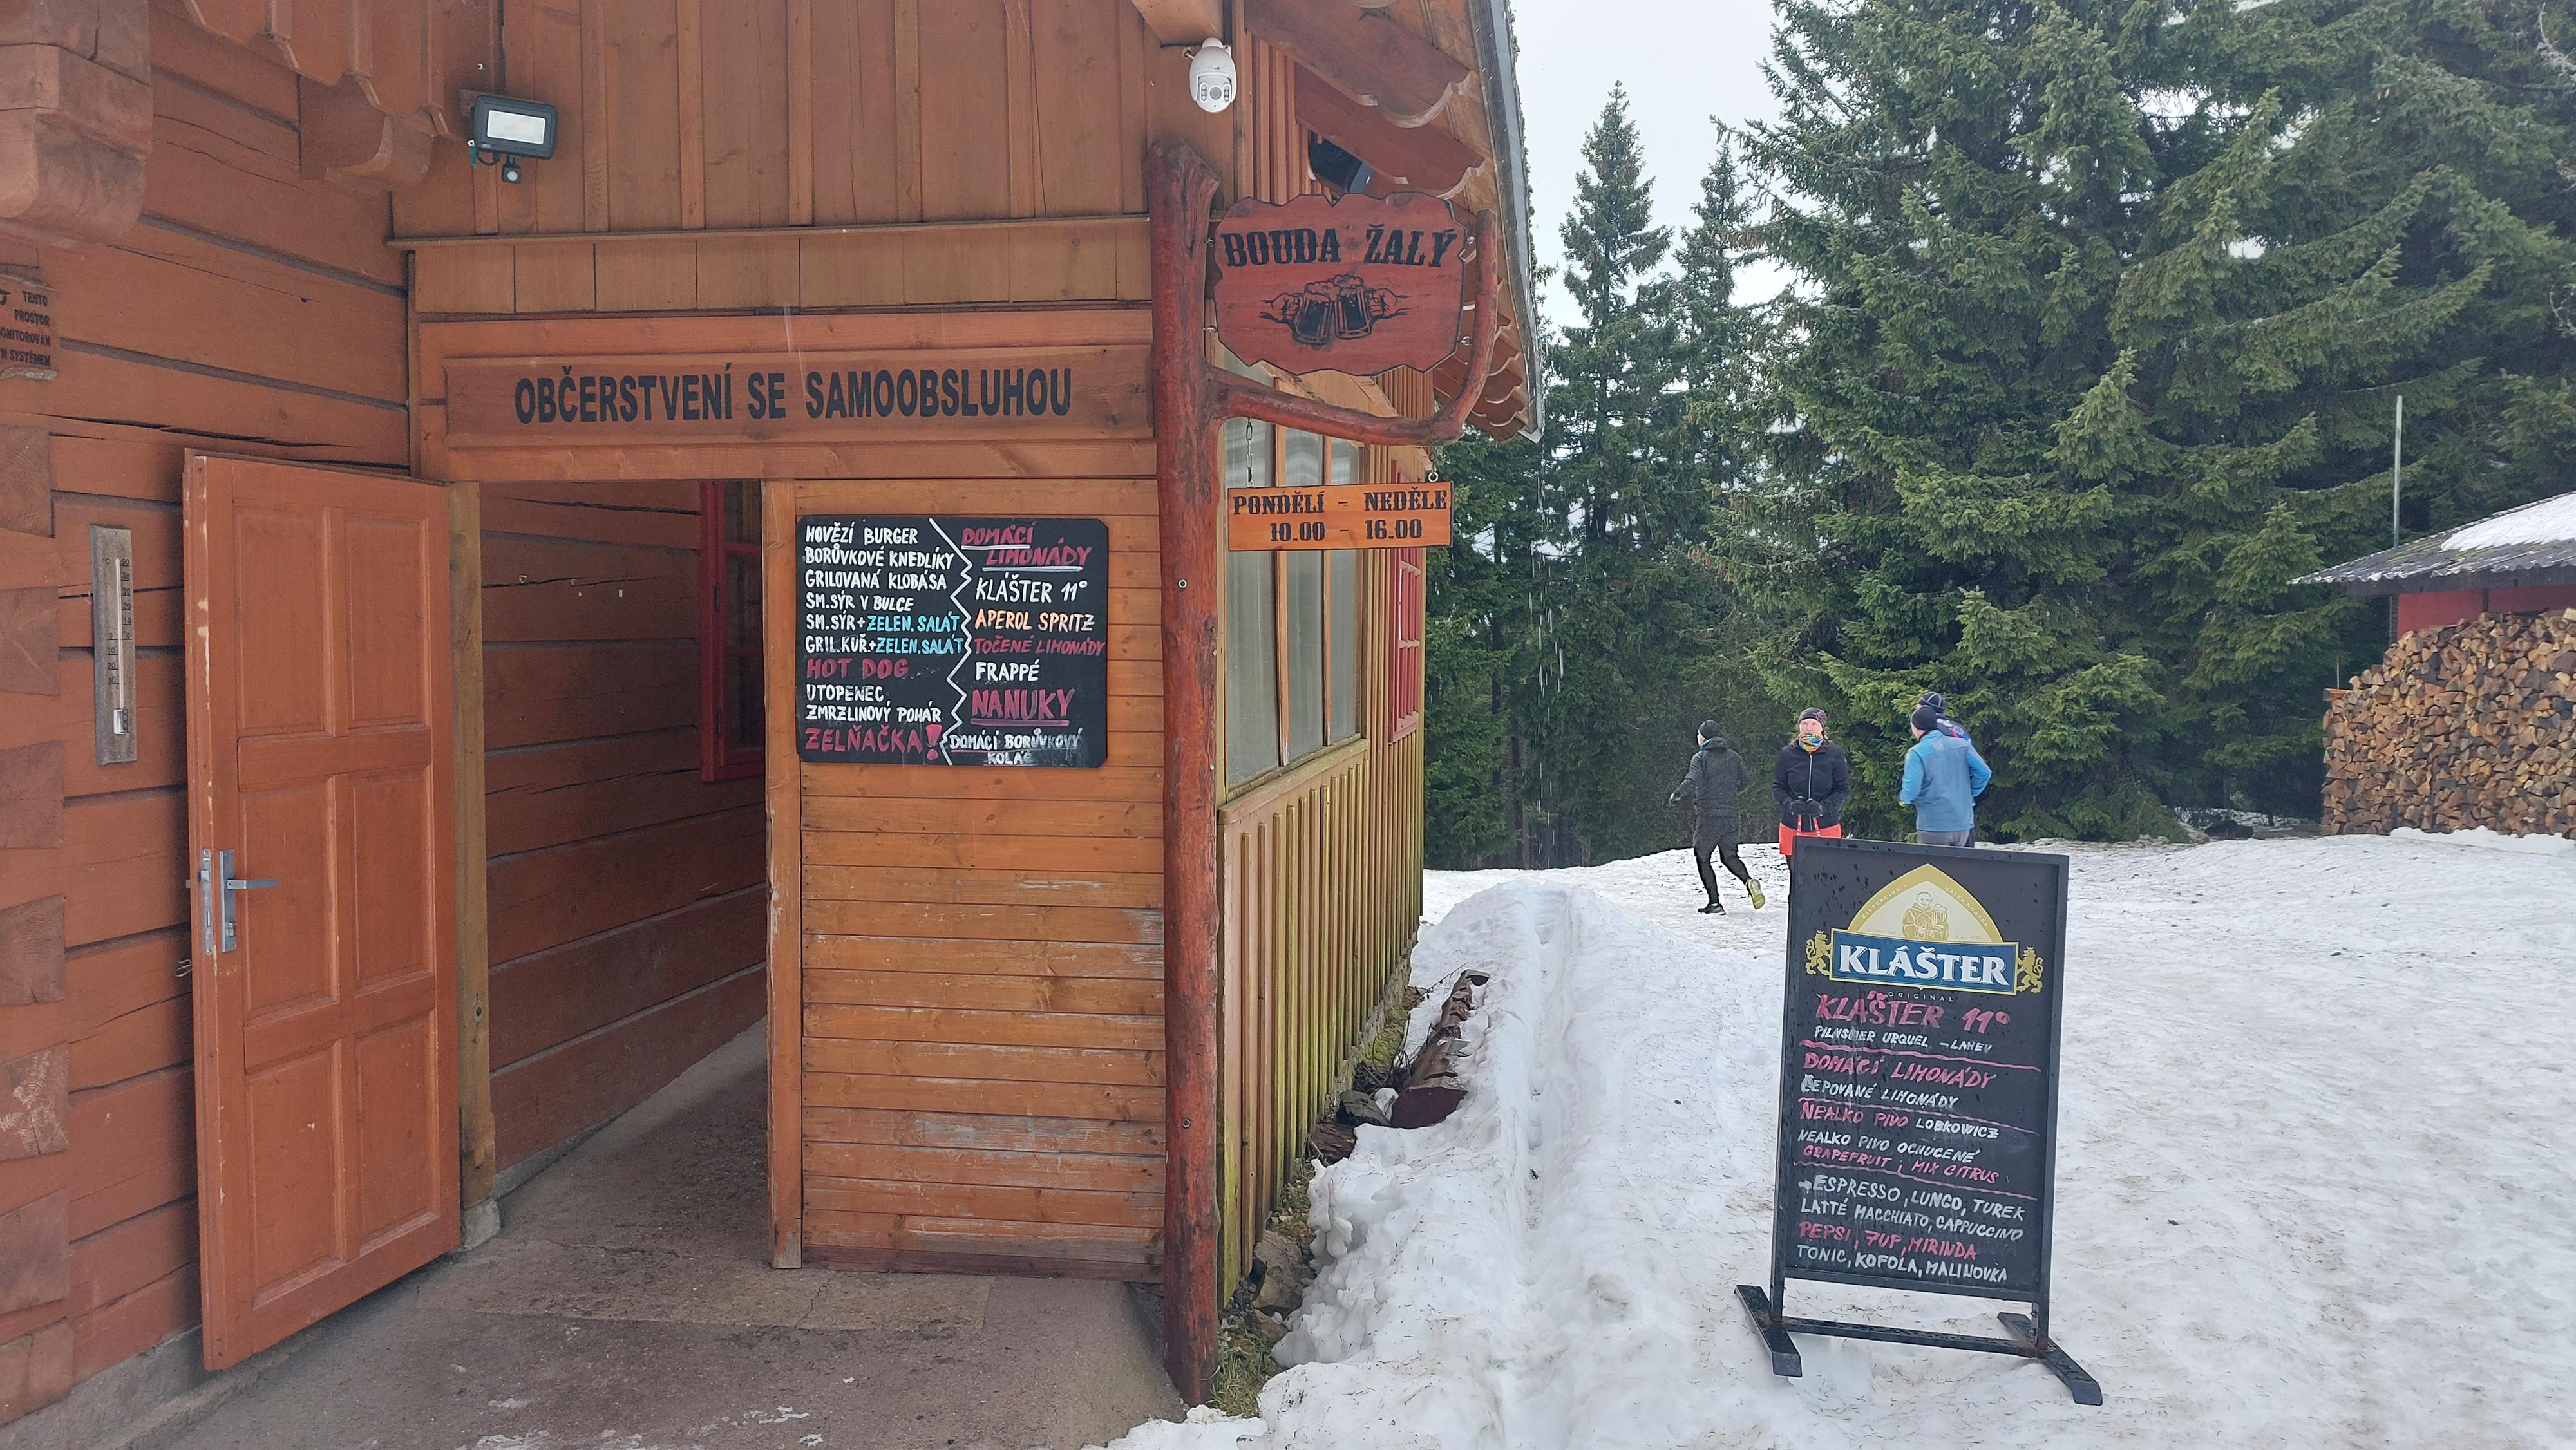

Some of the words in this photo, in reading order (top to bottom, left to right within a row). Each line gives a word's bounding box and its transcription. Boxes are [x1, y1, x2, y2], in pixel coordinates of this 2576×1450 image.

[1221, 228, 1340, 267] BOUDA
[1364, 223, 1457, 267] ŽALÝ
[23, 291, 48, 306] TENTO
[14, 309, 50, 327] PROSTOR
[0, 326, 50, 347] ONITOROVÁN
[10, 349, 50, 367] SYSTÉMEM
[515, 362, 733, 424] OBČERSTVENÍ
[747, 372, 786, 419] SE
[805, 368, 1072, 419] SAMOOBSLUHOU
[1233, 490, 1325, 515] PONDĚLÍ
[1363, 487, 1448, 512] NEDĚLE
[806, 521, 855, 544] HOVĚZÍ
[864, 527, 918, 545] BURGER
[961, 521, 1036, 545] DOMÁCÍ
[1270, 522, 1325, 542] 10.00
[1365, 519, 1423, 540] 16.00
[805, 543, 884, 567] BORŮVKOVÉ
[889, 546, 954, 570] KNEDLÍKY
[986, 537, 1093, 565] LIMONÁDY
[805, 569, 882, 588] GRILOVANÁ
[888, 569, 947, 591] KLOBÁSA
[975, 572, 1052, 603] KLÁŠTER
[860, 595, 868, 610] V
[873, 595, 914, 612] BULCE
[917, 611, 960, 632] SALÁT
[974, 608, 1032, 630] APEROL
[1038, 612, 1095, 632] SPRITZ
[974, 635, 1034, 654] TOČENÉ
[1035, 637, 1106, 656] LIMONÁDY
[806, 658, 853, 679] HOT
[862, 658, 909, 679] DOG
[976, 659, 1040, 681] FRAPPÉ
[806, 684, 884, 702] UTOPENEC
[971, 688, 1076, 720] NANUKY
[805, 699, 891, 722] ZMRZLINOVÝ
[896, 700, 942, 723] POHÁR
[949, 729, 999, 750] DOMÁCÍ
[1004, 727, 1083, 749] BORŮVKOVÝ
[1839, 945, 2010, 986] KLÁŠTER
[1888, 991, 1954, 1003] ORIGINAL
[1882, 1031, 1929, 1048] URQUEL
[1803, 1051, 1885, 1075] DOMÁCÍ
[1891, 1062, 1997, 1089] LIMONÁDY
[1801, 1073, 1878, 1098] ČEPOVANÉ
[1880, 1089, 1959, 1109] LIMONÁDY
[1799, 1101, 1865, 1124] NEALKO
[1875, 1113, 1909, 1127] PIVO
[1915, 1117, 2000, 1139] LOBKOWICZ
[1797, 1129, 1852, 1145] NEALKO
[1858, 1135, 1891, 1152] PIVO
[1897, 1142, 1980, 1164] OCHUCENÉ
[1911, 1159, 1940, 1175] MIX
[1943, 1164, 2000, 1184] CITRUS
[1800, 1198, 1848, 1216] LATTÉ
[1936, 1215, 2023, 1241] CAPPUCCINO
[1972, 1198, 2025, 1221] TUREK
[1908, 1237, 1977, 1260] MIRINDA
[1925, 1260, 2007, 1283] MALINOVKA
